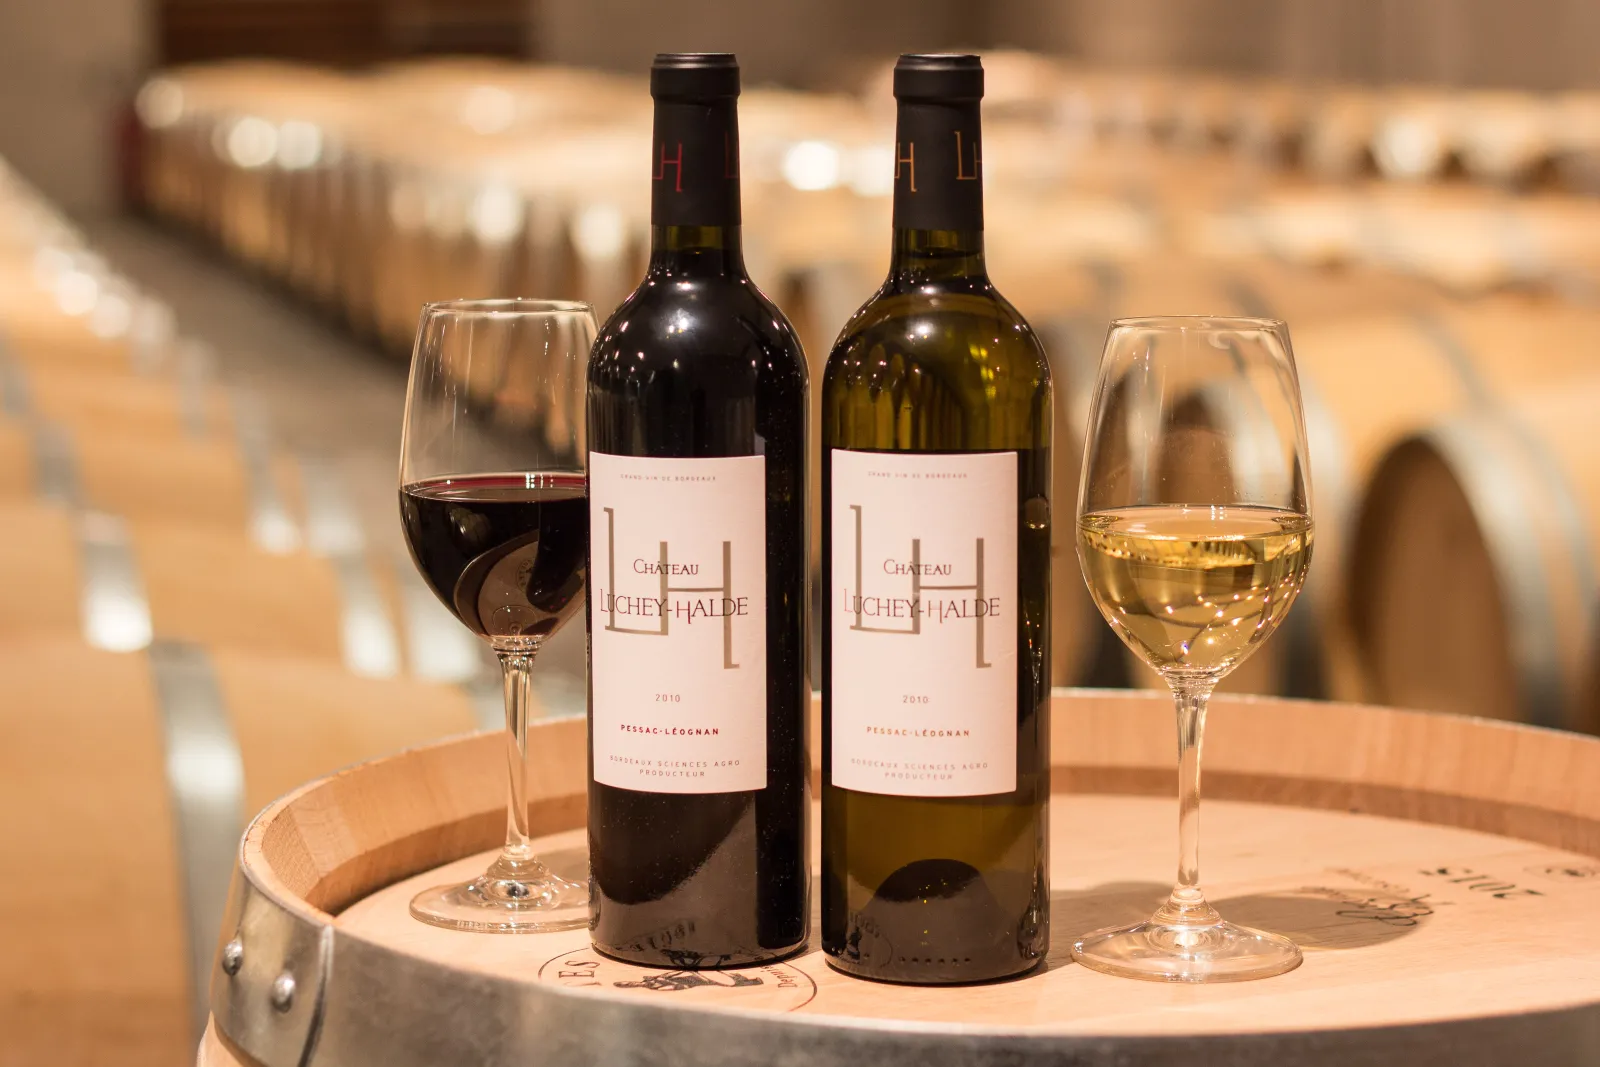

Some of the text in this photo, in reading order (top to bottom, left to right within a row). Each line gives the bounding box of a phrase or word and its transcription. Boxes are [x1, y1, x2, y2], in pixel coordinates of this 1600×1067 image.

[600, 588, 749, 625] LUCHEY-HALDE
[843, 588, 1001, 624] LUCHEY-HALDE
[655, 693, 681, 703] 2010
[902, 694, 930, 704] 2010
[620, 724, 720, 736] PESSAC-LÉOGNAN
[866, 726, 970, 737] PESSAC-LÉOGNAN
[609, 755, 741, 768] BORDEAUX SCIENCES AGRO
[904, 763, 956, 771] SCIENCES
[962, 762, 989, 770] AGRO
[639, 769, 706, 778] PRODUCTEUR
[884, 772, 954, 781] PRODUCTEUR
